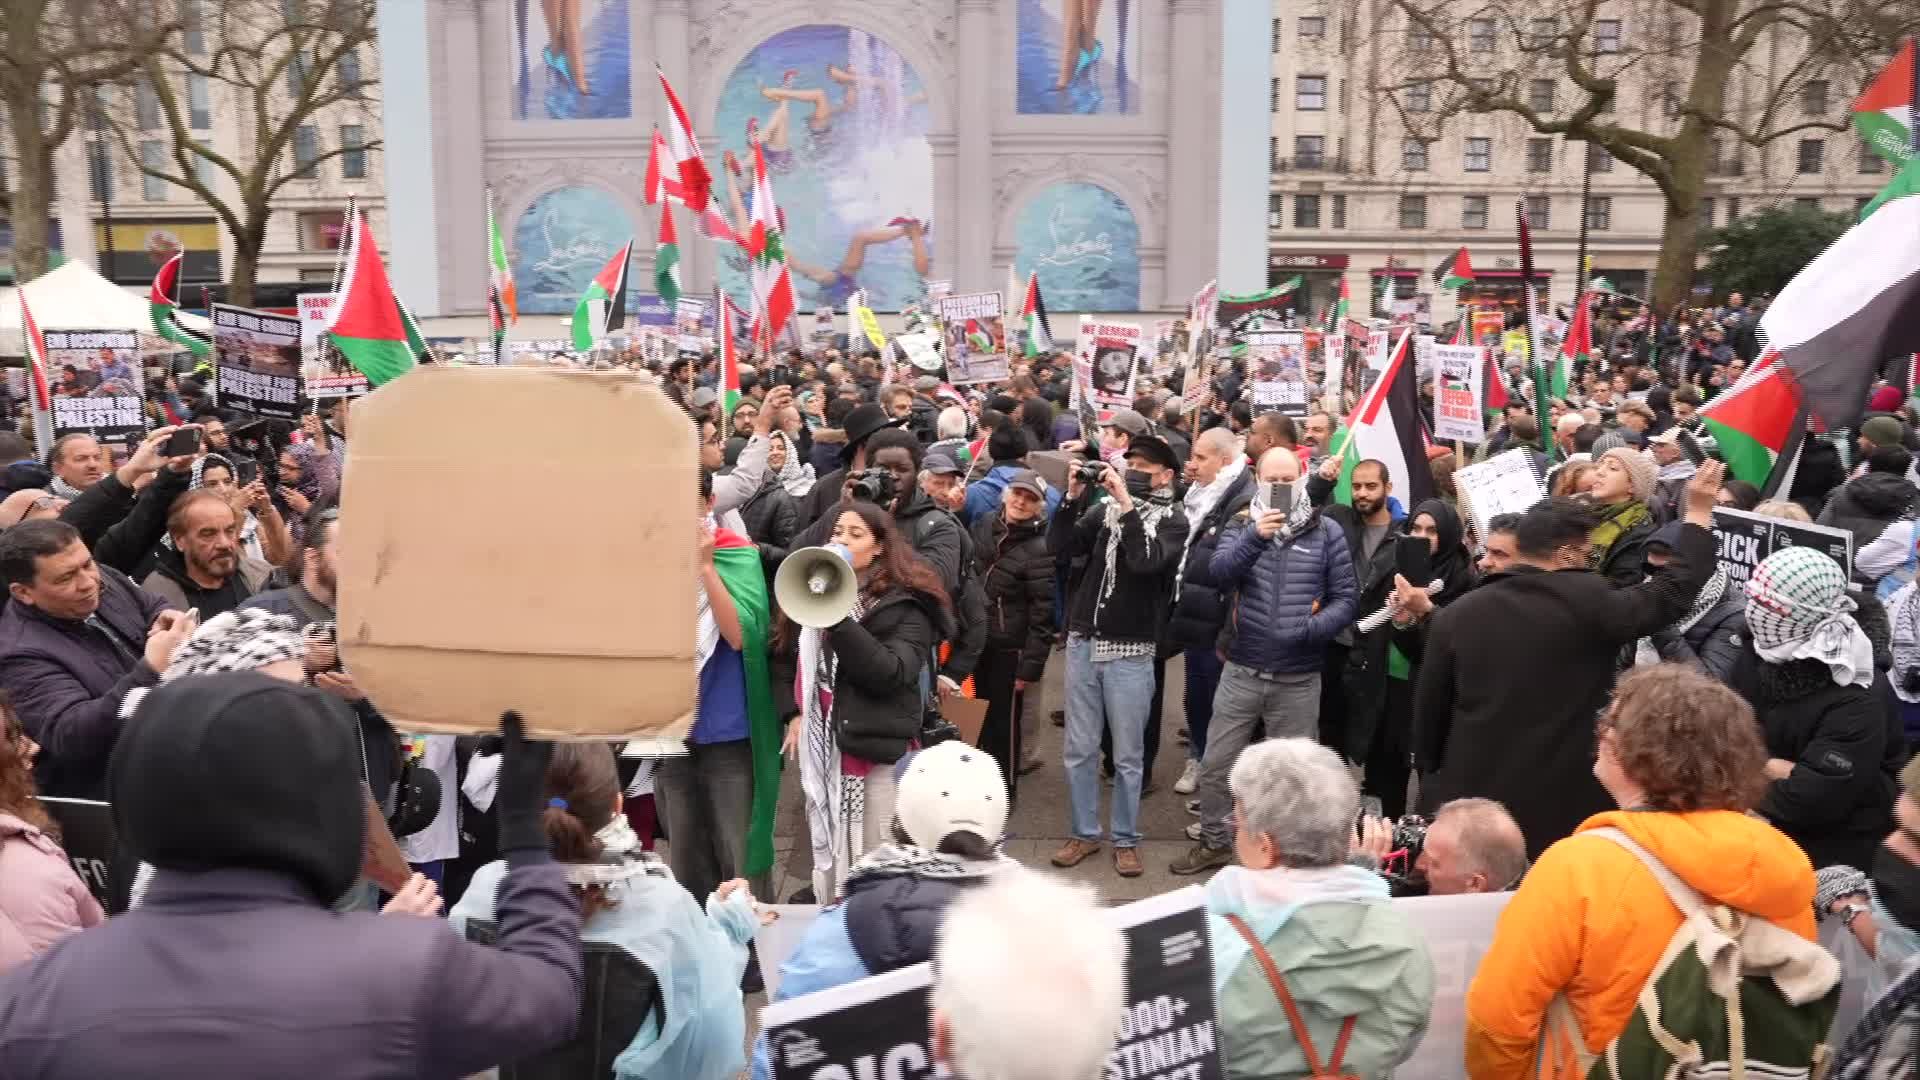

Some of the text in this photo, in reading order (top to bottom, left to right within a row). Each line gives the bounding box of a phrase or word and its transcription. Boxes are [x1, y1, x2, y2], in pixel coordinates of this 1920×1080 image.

[216, 311, 300, 337] END WAR CRIMES
[1098, 325, 1140, 338] DEMAND
[46, 333, 70, 349] END
[219, 366, 272, 388] FREEDOM
[272, 374, 298, 395] FOR
[219, 377, 298, 405] PALESTINE
[54, 397, 141, 411] FREEDOM FOR
[55, 410, 145, 429] PALESTINE
